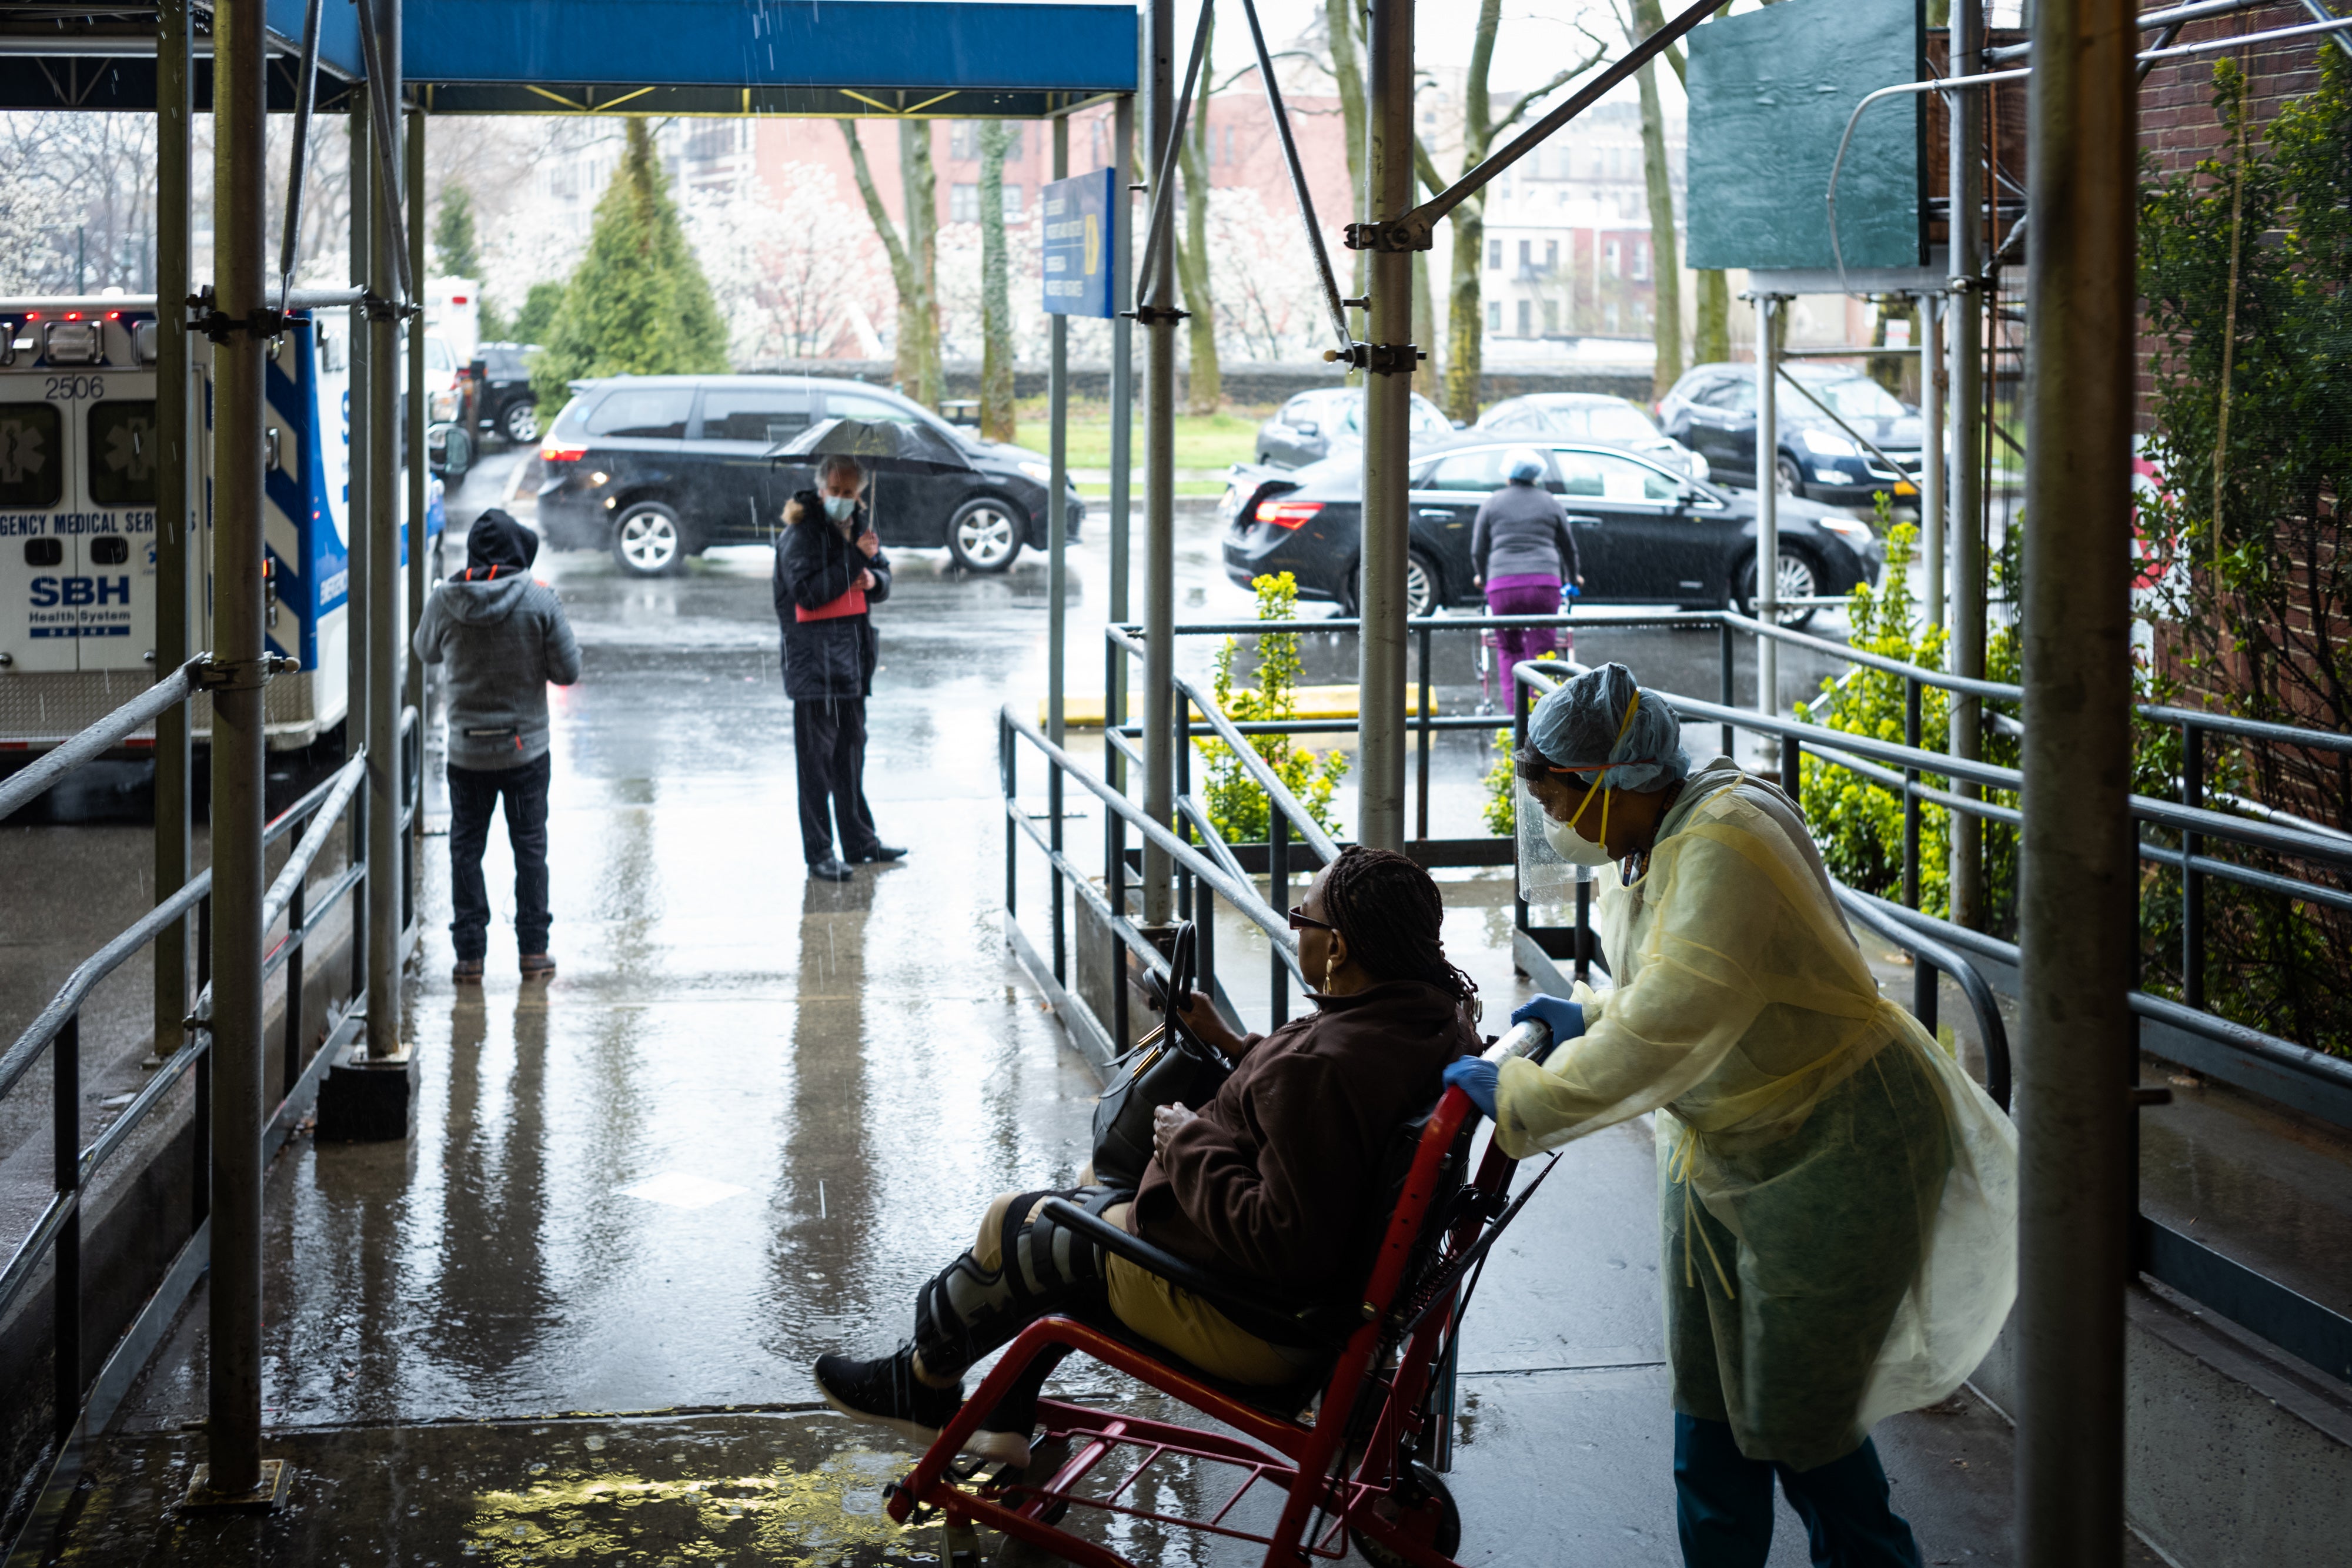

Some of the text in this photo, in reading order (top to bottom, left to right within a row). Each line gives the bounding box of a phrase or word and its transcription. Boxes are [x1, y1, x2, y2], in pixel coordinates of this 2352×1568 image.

[45, 376, 103, 400] 2506
[54, 511, 118, 534] MEDICAL
[30, 575, 129, 607] SBH
[30, 610, 130, 623] Health System
